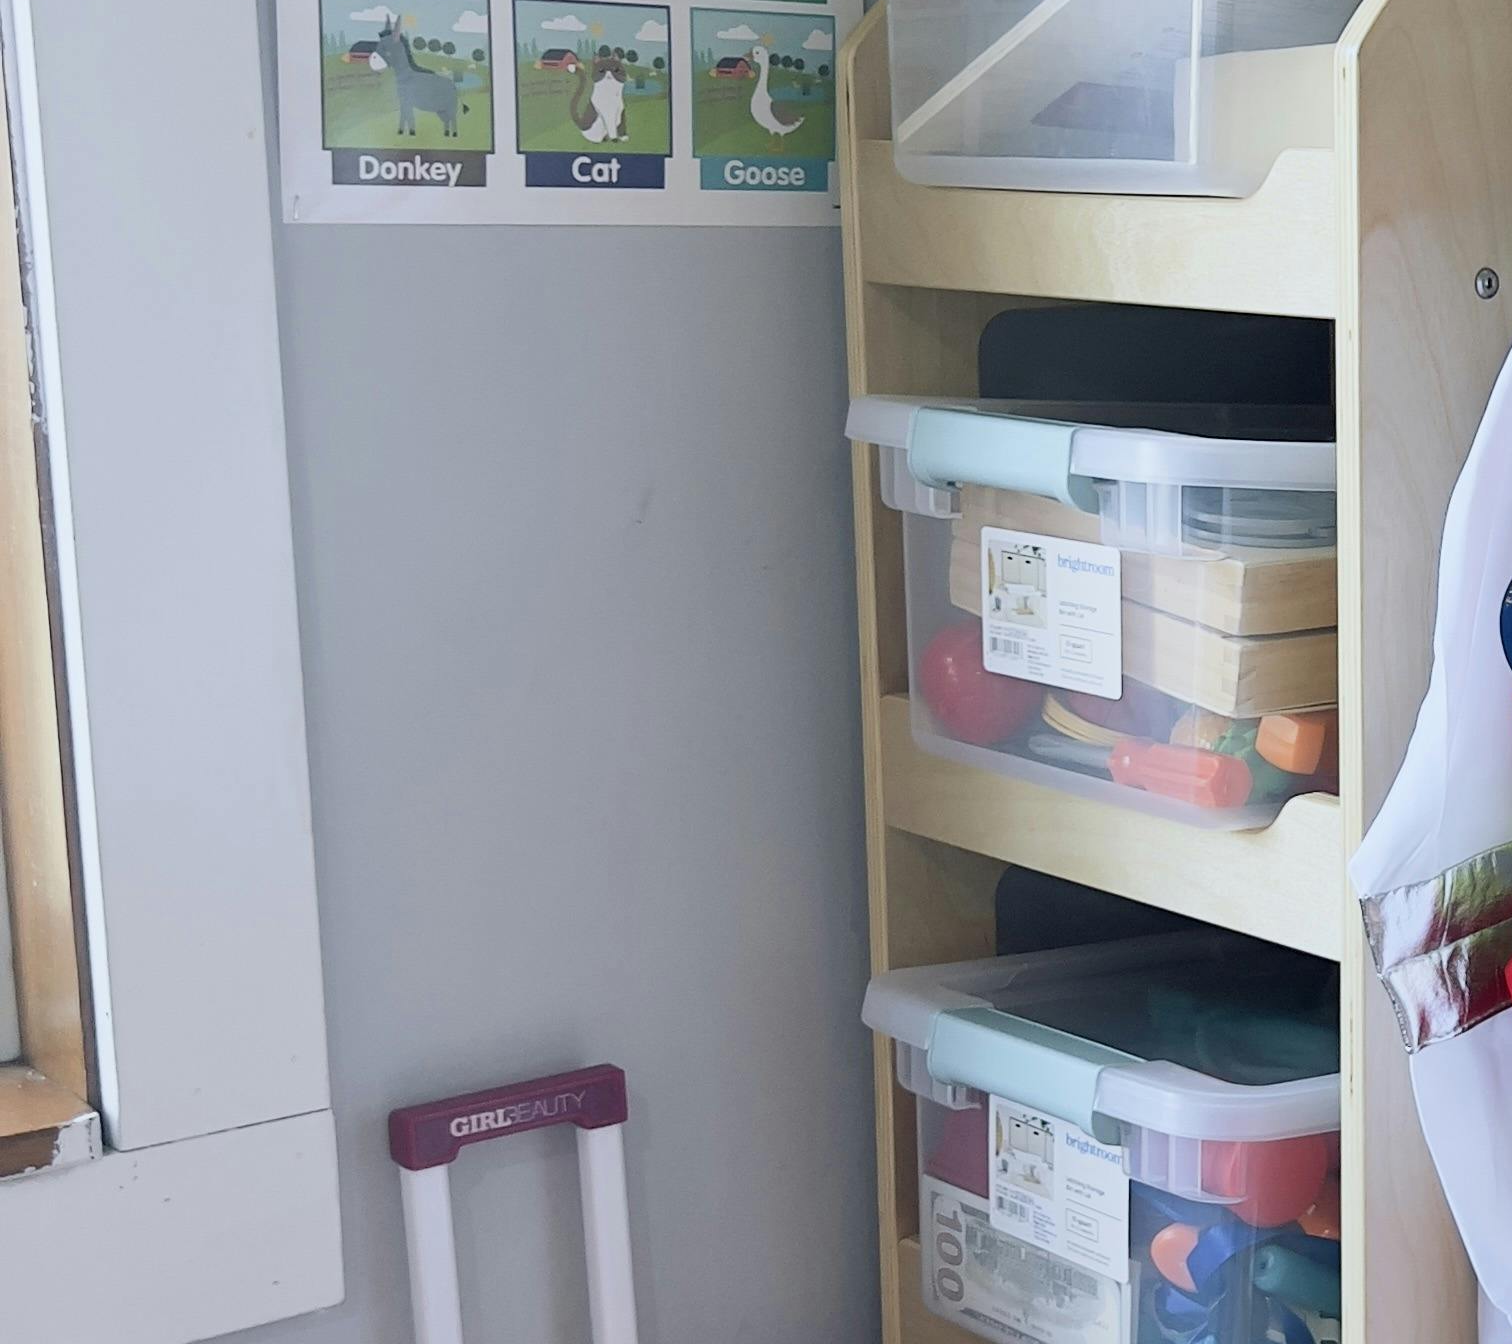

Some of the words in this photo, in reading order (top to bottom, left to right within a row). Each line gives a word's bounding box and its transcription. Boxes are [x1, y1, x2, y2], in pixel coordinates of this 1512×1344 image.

[358, 156, 462, 188] Donkey
[571, 157, 621, 185] Cat
[723, 162, 806, 187] Goose
[1057, 552, 1115, 578] brightroom
[936, 1206, 965, 1303] 100
